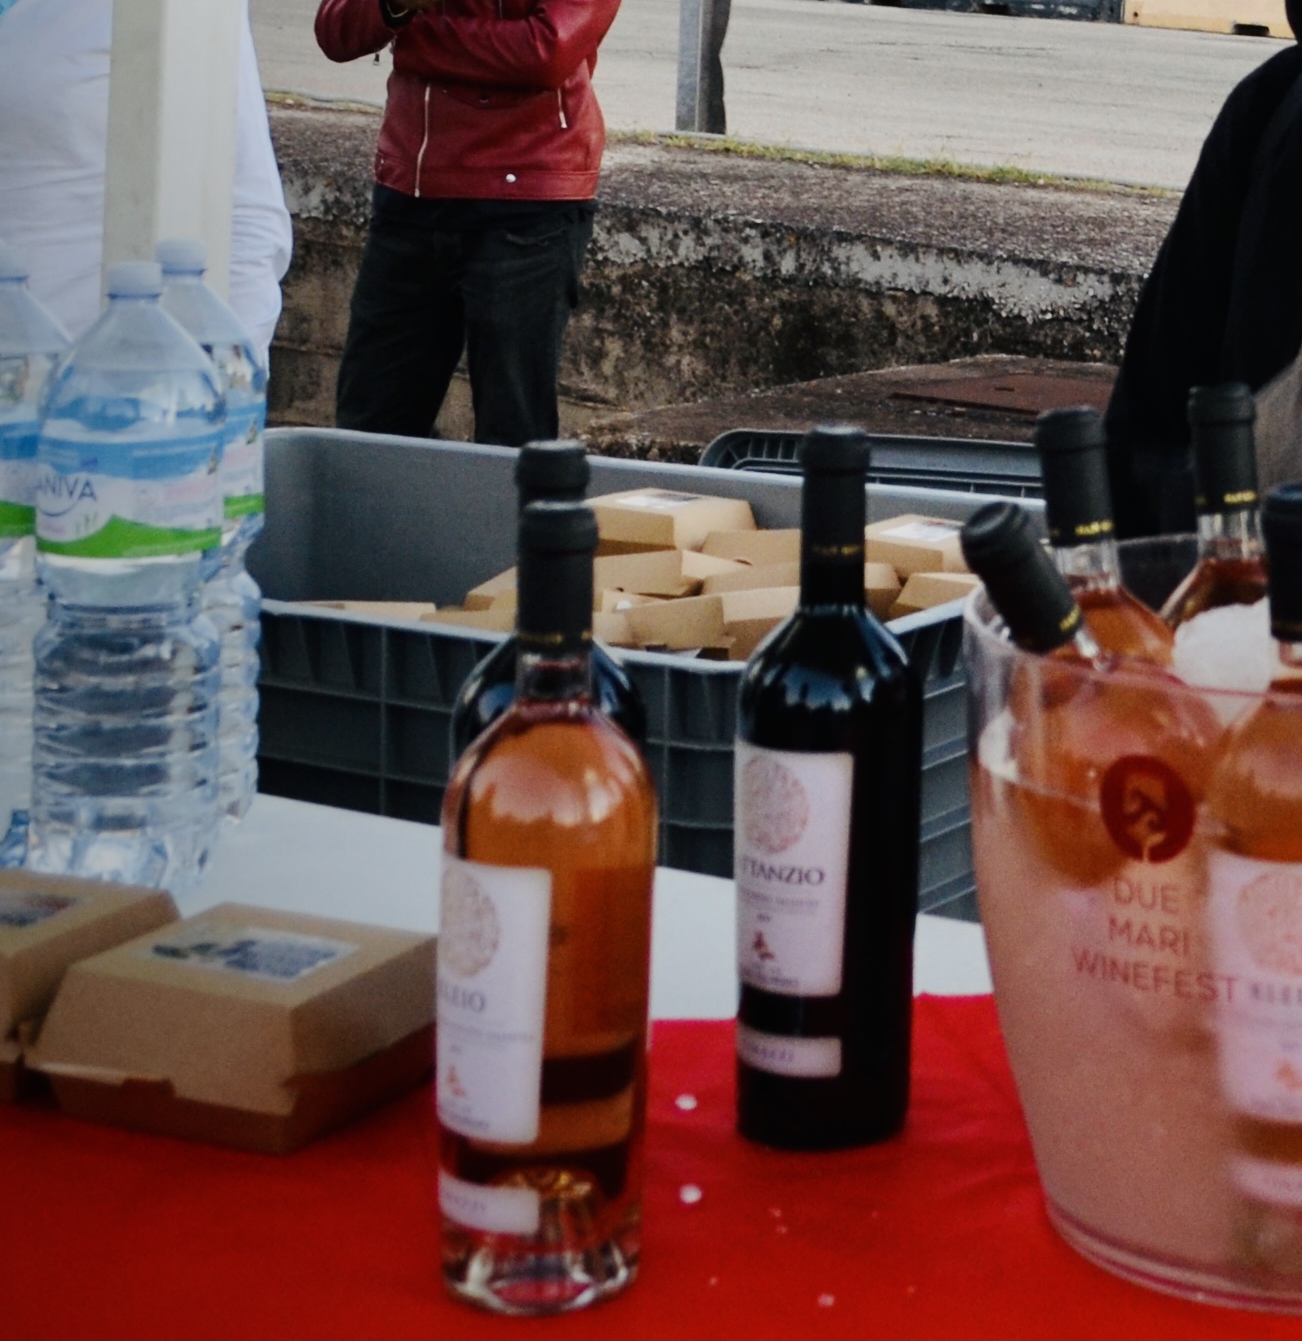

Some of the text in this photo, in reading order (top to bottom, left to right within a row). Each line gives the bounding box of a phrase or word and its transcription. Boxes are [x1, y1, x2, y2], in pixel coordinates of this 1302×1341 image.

[742, 856, 824, 886] TTANZIO
[1114, 878, 1181, 915] DUE
[1108, 915, 1190, 956] MARI
[1071, 945, 1239, 1002] WINEFEST
